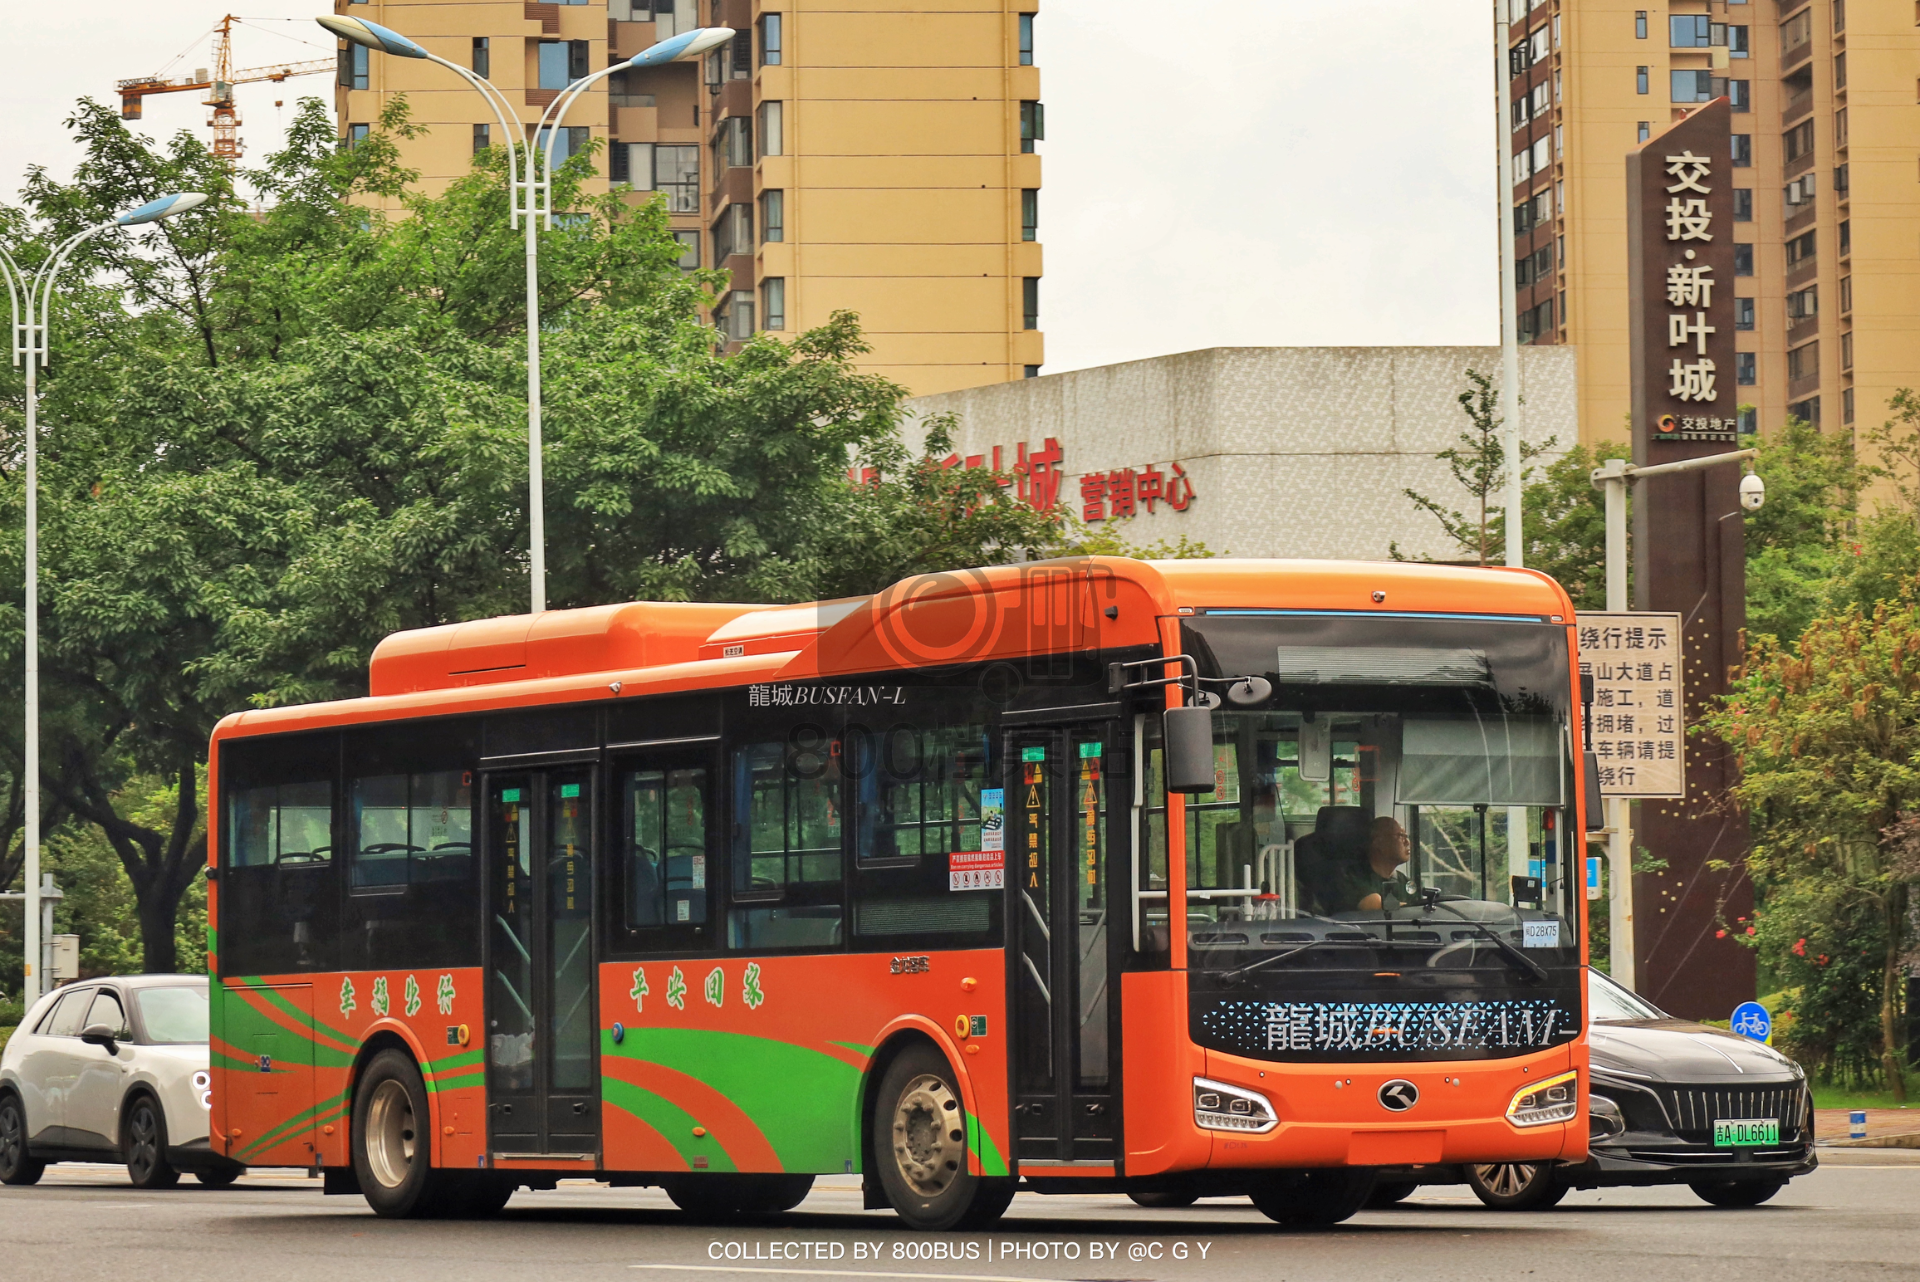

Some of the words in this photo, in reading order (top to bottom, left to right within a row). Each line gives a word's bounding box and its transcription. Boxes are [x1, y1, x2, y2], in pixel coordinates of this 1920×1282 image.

[1682, 417, 1736, 430] 交投地产
[1080, 462, 1196, 522] 营销中心
[1580, 627, 1667, 650] 绕行提示
[630, 962, 764, 1013] 平安回家
